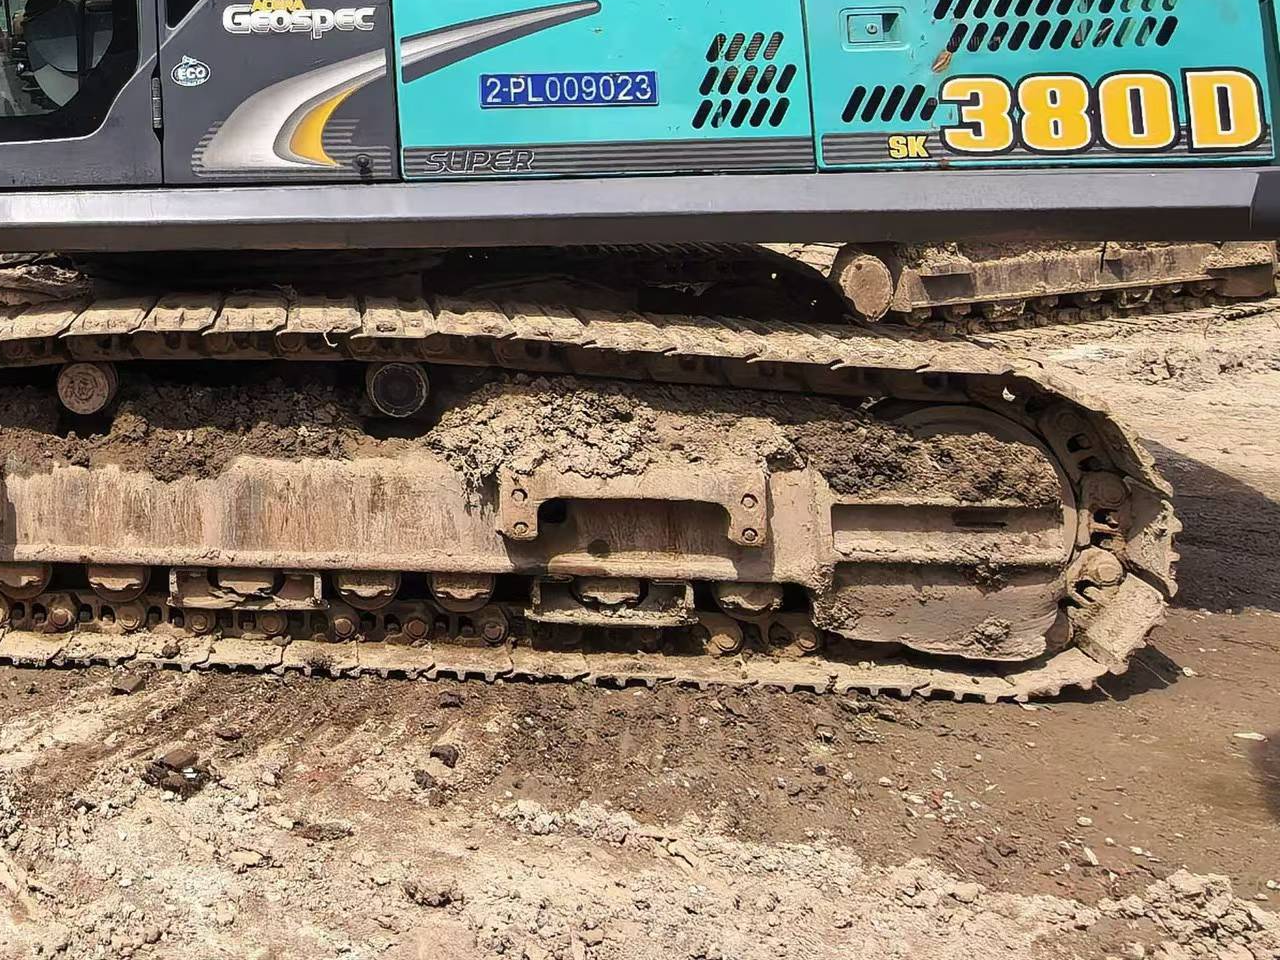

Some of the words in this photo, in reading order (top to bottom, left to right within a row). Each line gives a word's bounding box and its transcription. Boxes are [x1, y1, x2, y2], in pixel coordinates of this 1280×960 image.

[177, 66, 206, 79] ECO
[486, 75, 652, 103] 2-PL009023
[888, 135, 930, 159] SK
[423, 148, 535, 174] SUPER
